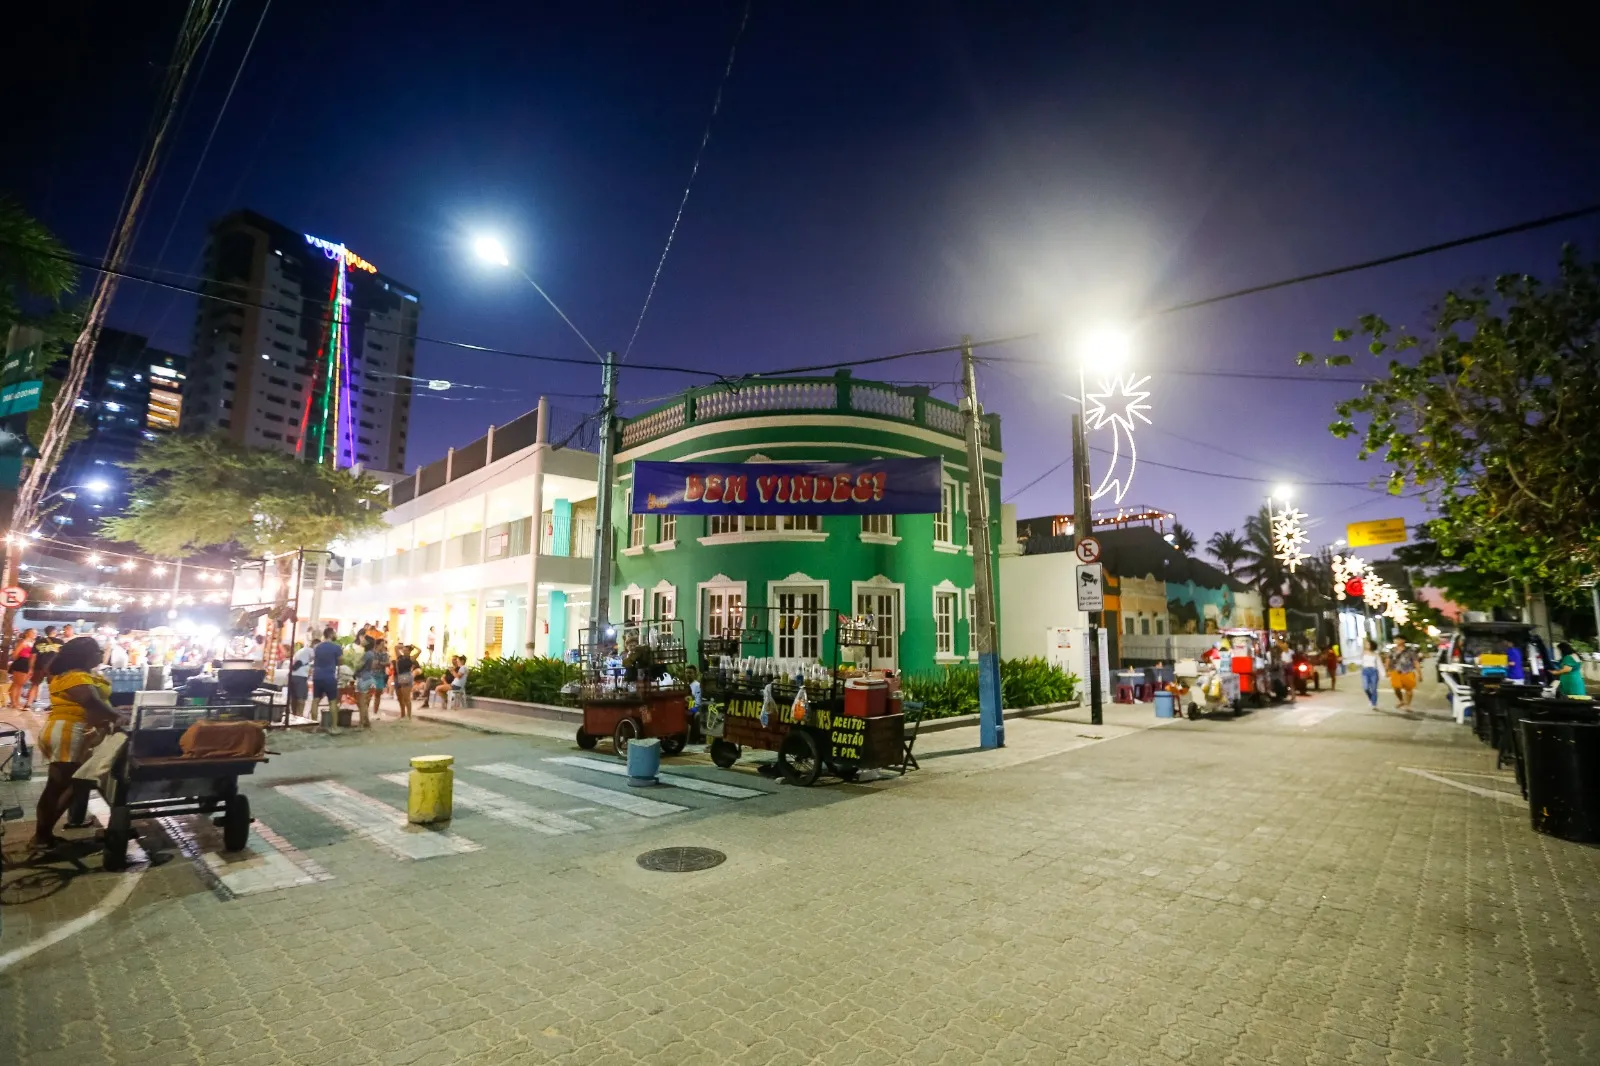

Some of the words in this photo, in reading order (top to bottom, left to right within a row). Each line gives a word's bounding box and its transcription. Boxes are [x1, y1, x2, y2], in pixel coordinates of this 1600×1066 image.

[684, 473, 748, 504] BEM
[756, 471, 887, 504] VINDES!
[727, 699, 763, 719] ALINE
[833, 716, 865, 730] ACEITO:
[831, 730, 864, 746] CARTÃO
[832, 746, 837, 757] E
